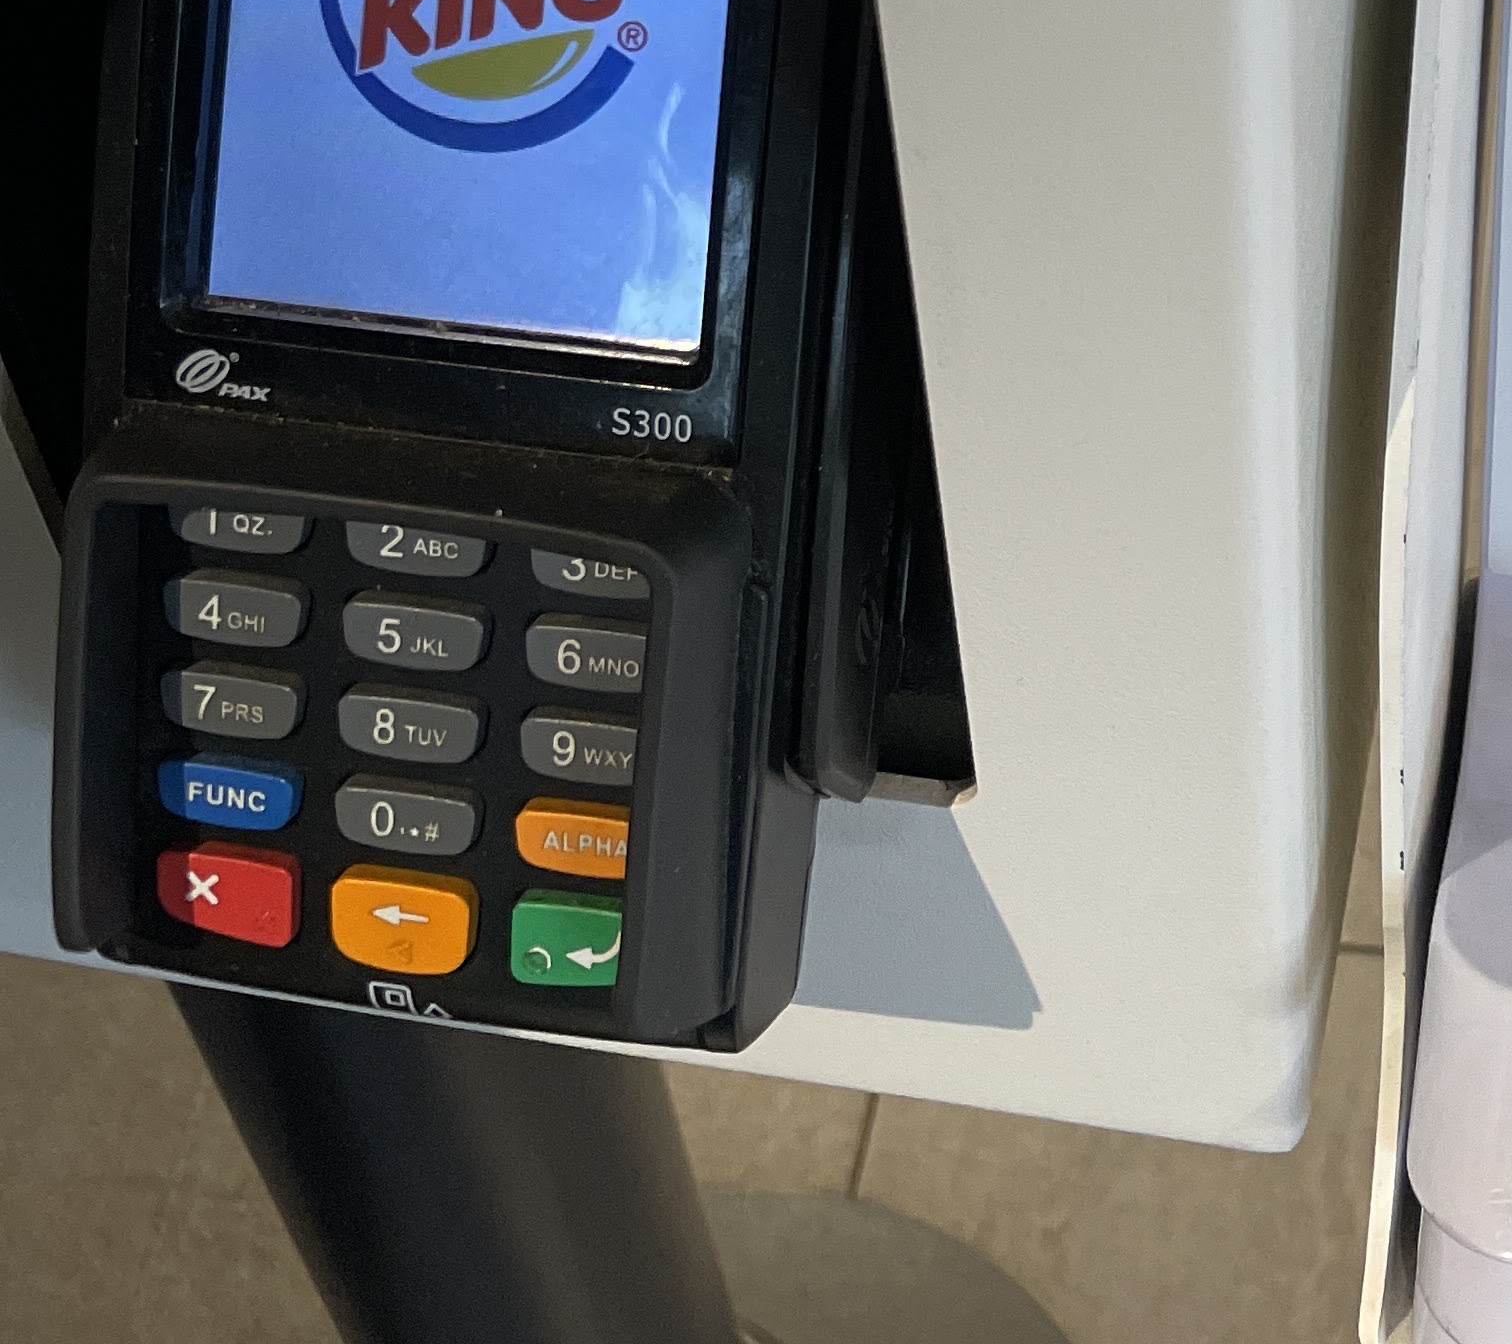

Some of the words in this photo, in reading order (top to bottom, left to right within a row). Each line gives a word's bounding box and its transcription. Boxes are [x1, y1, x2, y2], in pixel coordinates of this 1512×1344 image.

[218, 382, 271, 402] PAX
[611, 407, 692, 443] S300
[379, 524, 404, 558] 2
[413, 538, 459, 559] ABC
[198, 594, 222, 630] 4
[227, 612, 265, 633] GHI
[377, 618, 401, 653] 5
[410, 636, 449, 657] JKL
[557, 639, 582, 675] 6
[588, 656, 640, 678] MNO
[193, 684, 217, 720] 7
[221, 701, 264, 724] PRS
[373, 708, 395, 745] 8
[404, 725, 447, 747] TUV
[553, 731, 576, 766] 9
[584, 746, 632, 769] WXY
[187, 781, 266, 812] FUNC
[543, 830, 627, 858] ALPHA
